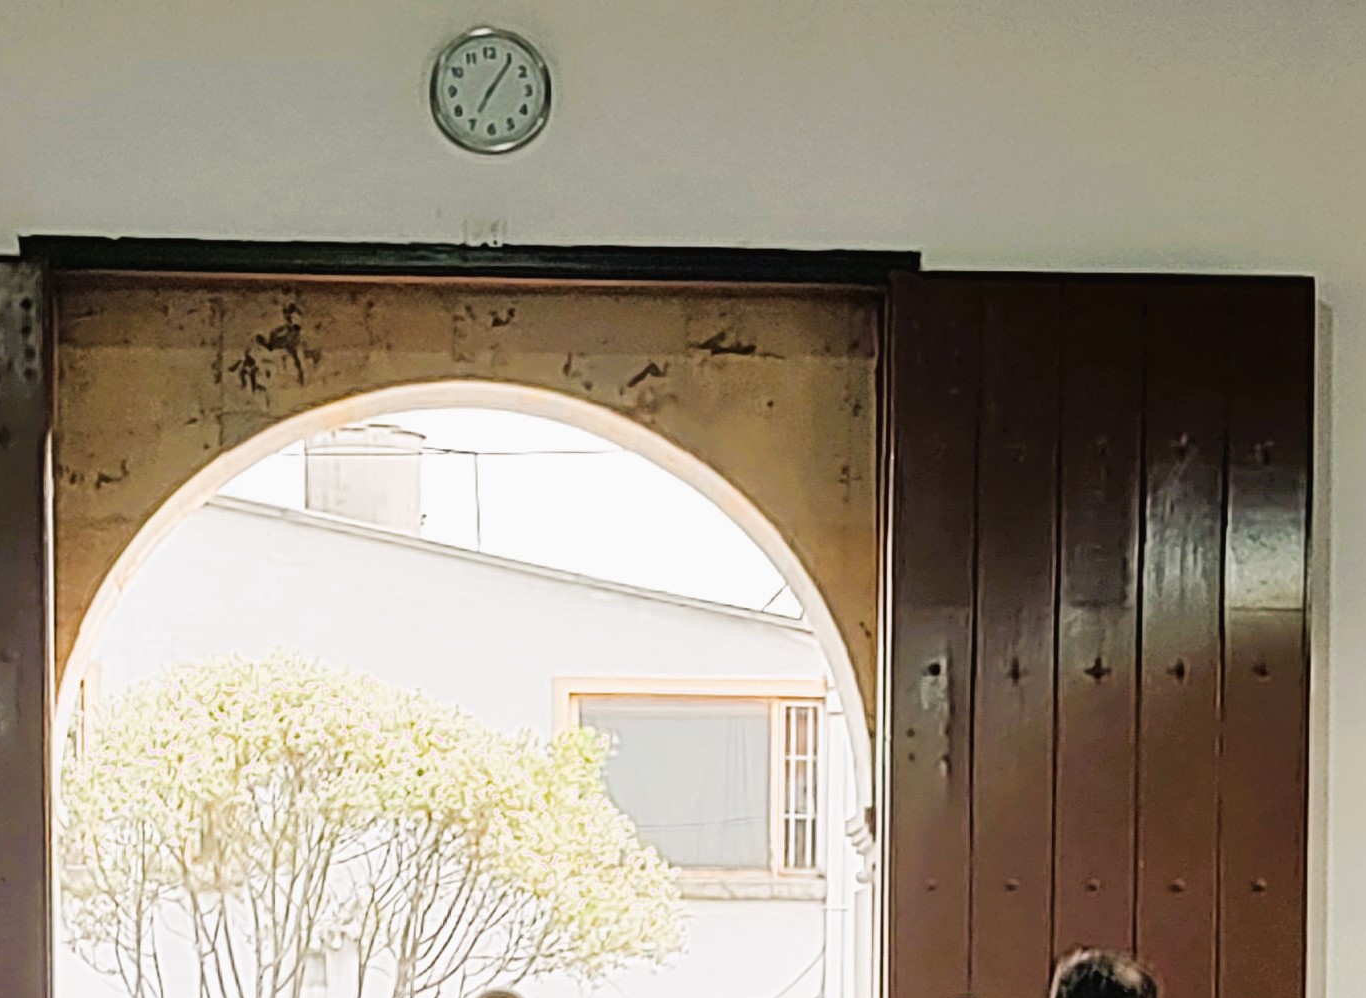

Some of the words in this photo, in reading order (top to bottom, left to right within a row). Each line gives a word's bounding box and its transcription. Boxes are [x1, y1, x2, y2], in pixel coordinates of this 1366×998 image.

[466, 52, 477, 65] 11
[483, 47, 497, 60] 12
[451, 66, 463, 78] 10
[518, 65, 527, 78] 2
[448, 85, 457, 98] 9
[524, 84, 533, 97] 3
[454, 104, 463, 117] 8
[519, 103, 528, 115] 4
[468, 118, 477, 131] 7
[487, 123, 496, 135] 6
[506, 117, 515, 131] 5
